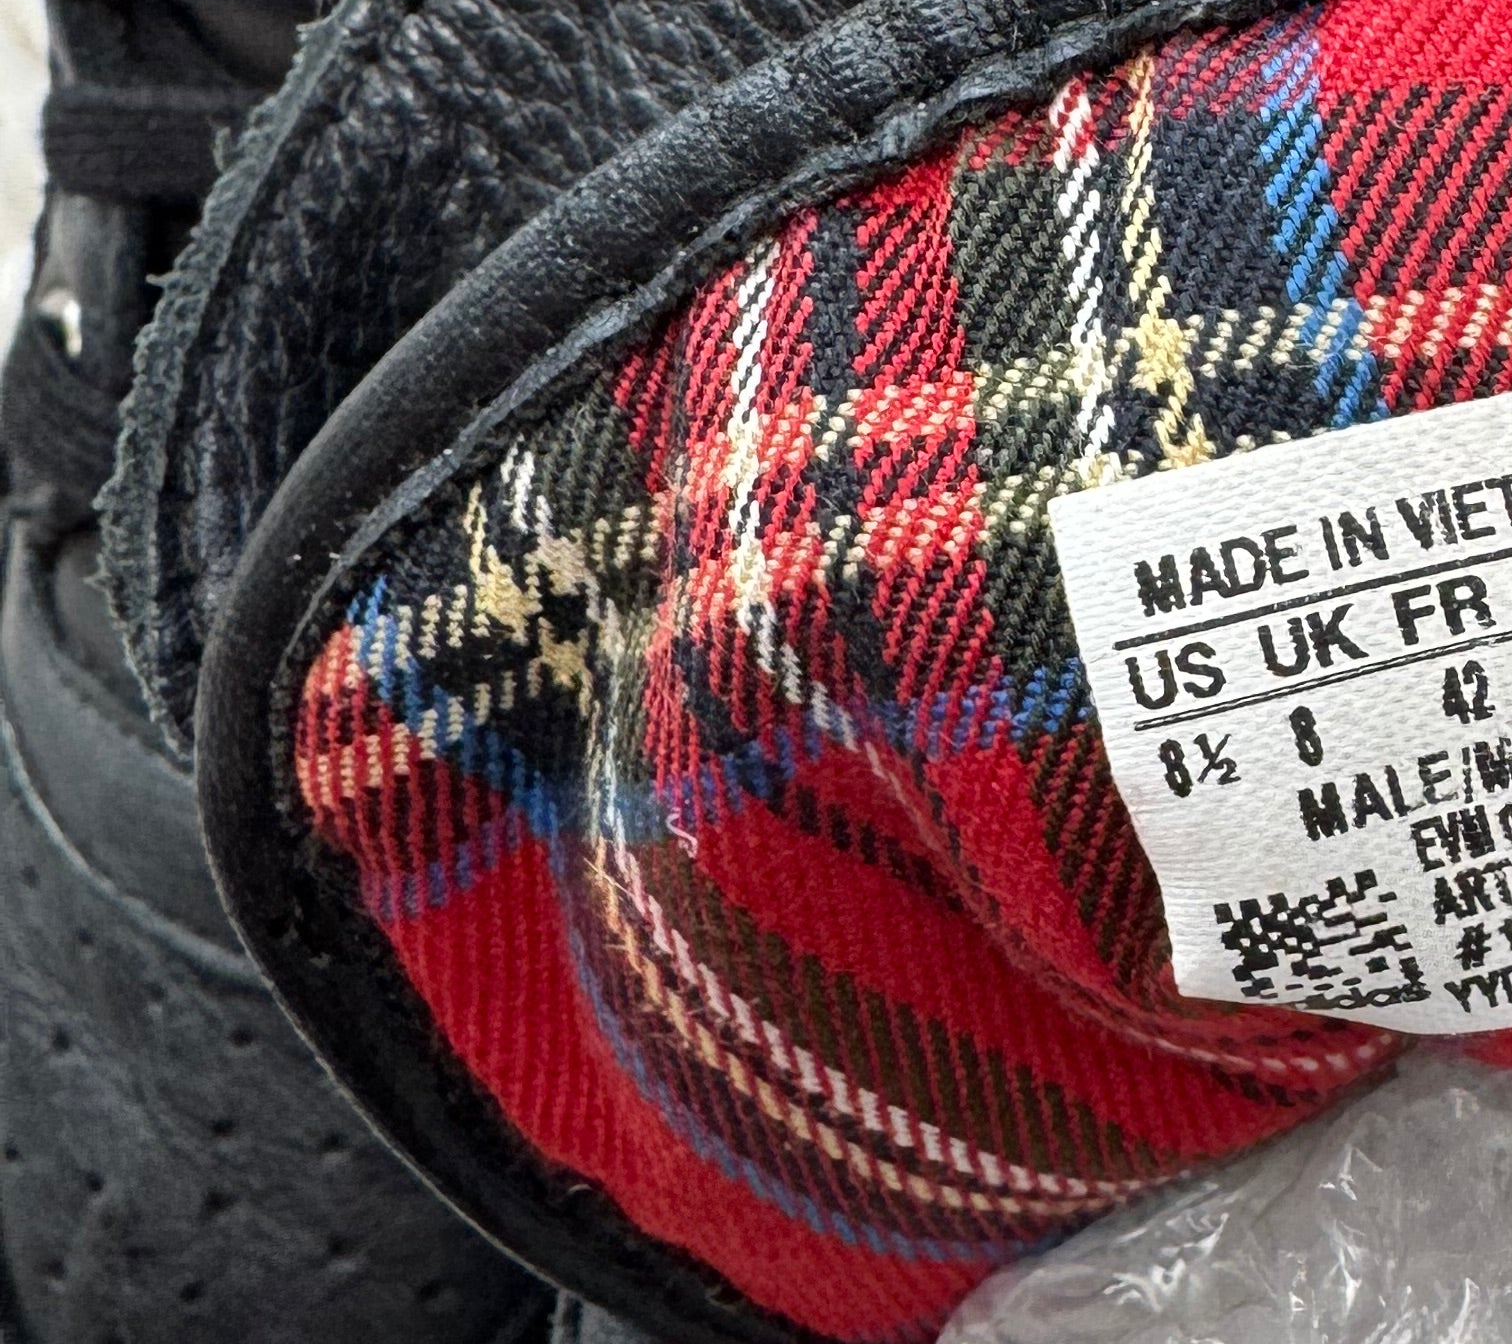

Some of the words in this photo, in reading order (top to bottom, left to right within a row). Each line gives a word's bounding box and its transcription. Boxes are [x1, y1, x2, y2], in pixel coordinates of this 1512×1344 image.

[1134, 525, 1309, 617] MADE
[1319, 507, 1390, 570] IN
[1125, 642, 1227, 710] US
[1258, 603, 1369, 677] UK
[1391, 575, 1496, 646] FR
[1289, 706, 1324, 767] 8
[1442, 660, 1496, 724] 42
[1410, 804, 1496, 873] EVM
